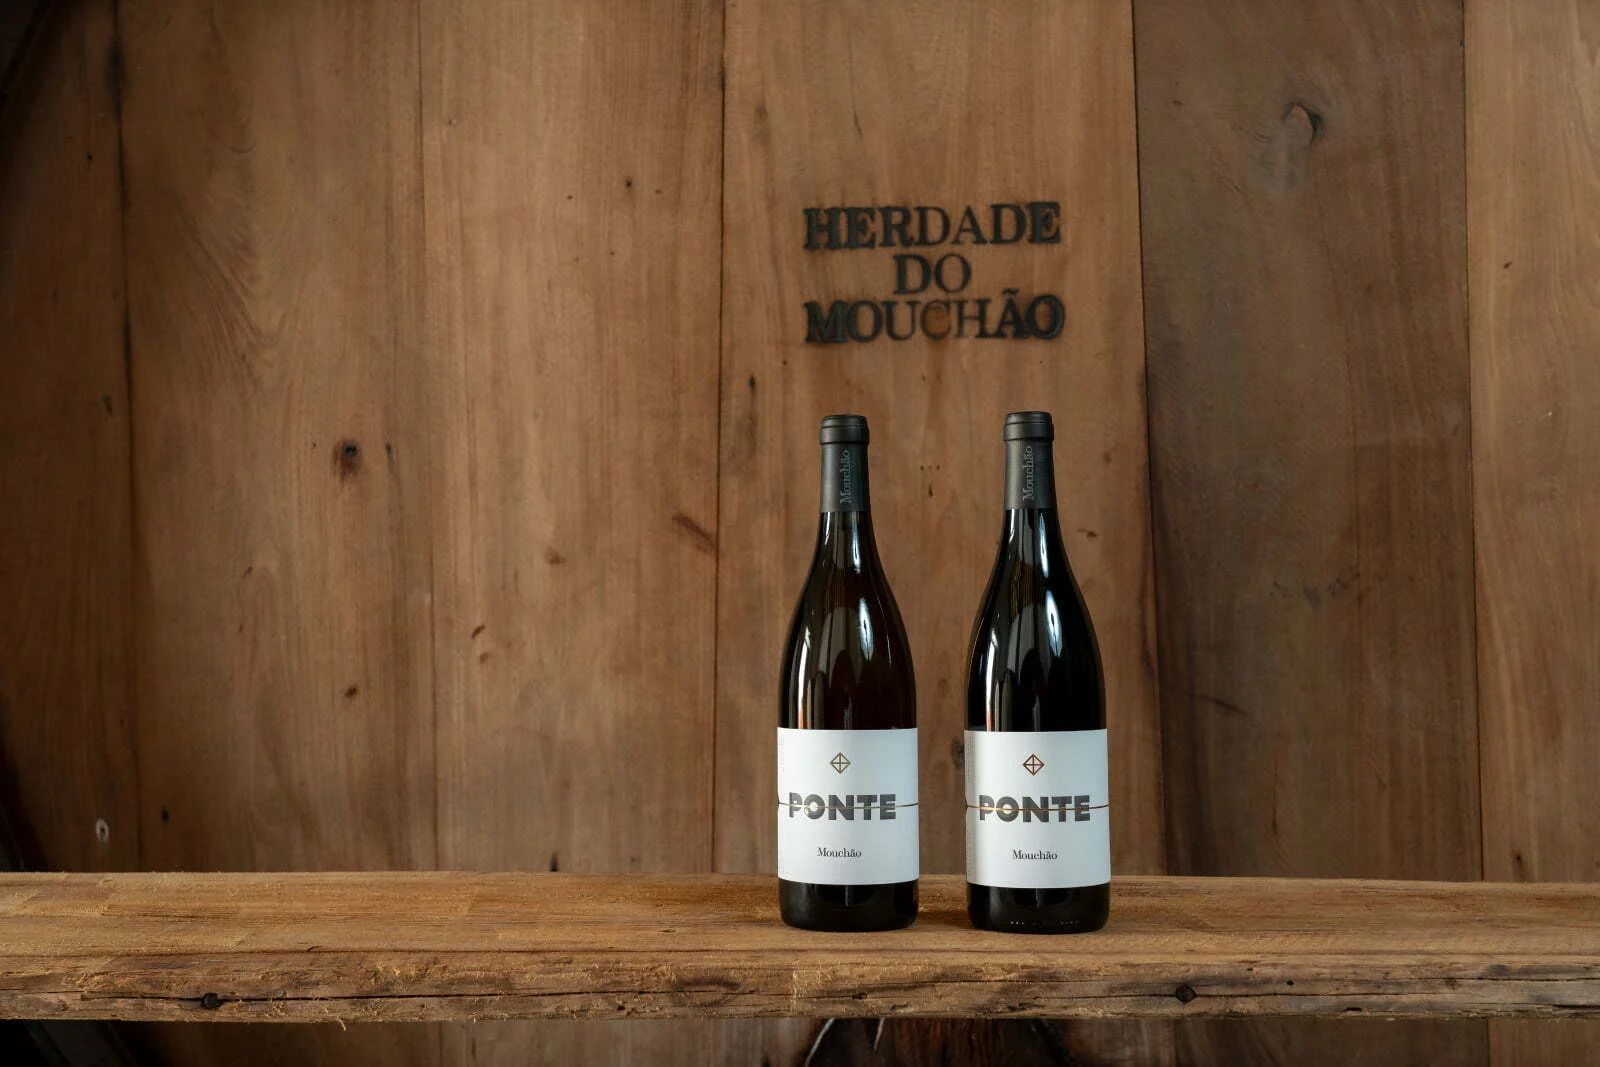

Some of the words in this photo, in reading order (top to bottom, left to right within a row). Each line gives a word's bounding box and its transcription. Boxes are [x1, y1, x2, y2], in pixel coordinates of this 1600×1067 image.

[803, 201, 1061, 250] HERDADE
[893, 253, 972, 294] DO
[804, 288, 1065, 343] MOUCHÃO
[1022, 445, 1034, 501] Mouchão
[789, 792, 897, 821] PONTE
[979, 794, 1091, 823] PONTE
[817, 847, 862, 858] Mouchão
[1012, 849, 1059, 860] Mouchão
